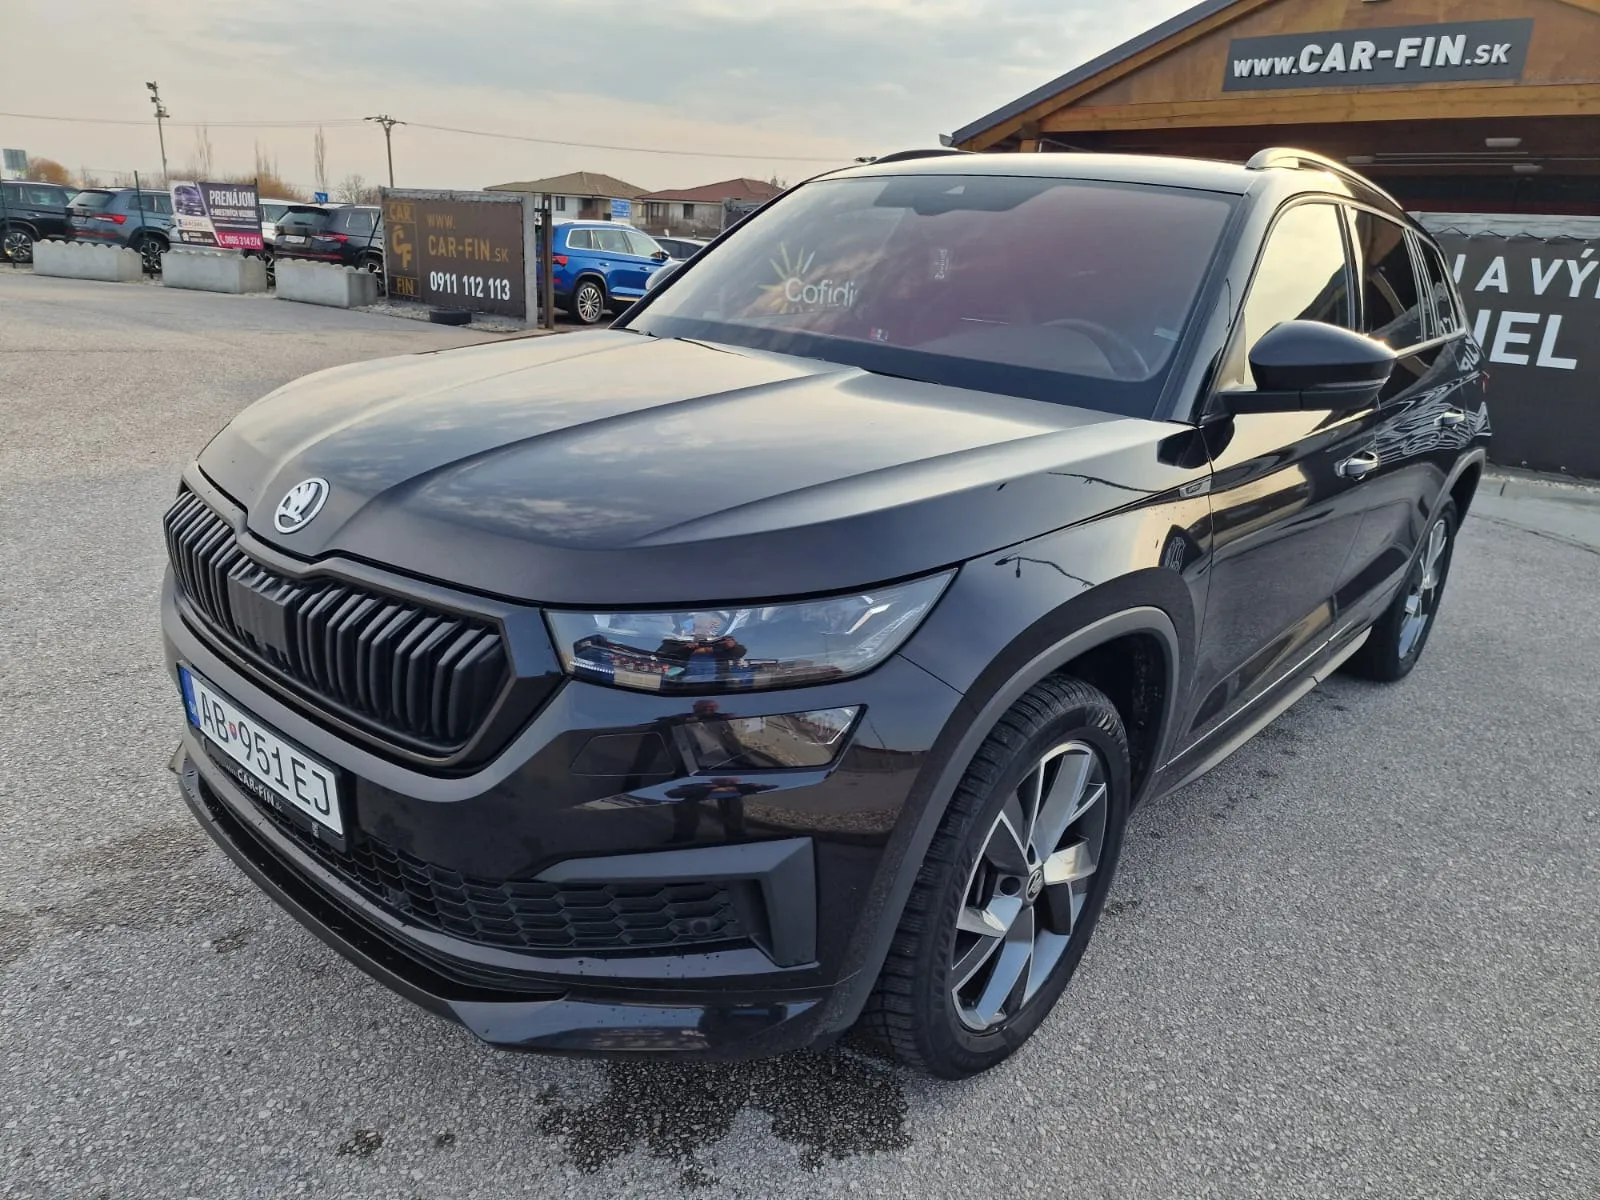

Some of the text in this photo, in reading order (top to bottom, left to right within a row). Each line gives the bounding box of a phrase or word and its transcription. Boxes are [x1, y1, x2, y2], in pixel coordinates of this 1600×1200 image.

[209, 189, 256, 207] PRENÁJOM
[389, 203, 412, 220] CAR
[1474, 256, 1509, 293] A
[1531, 248, 1600, 299] VÝ
[397, 277, 414, 295] FIN
[430, 271, 510, 300] 0911 112 113
[785, 277, 858, 307] Cofidi
